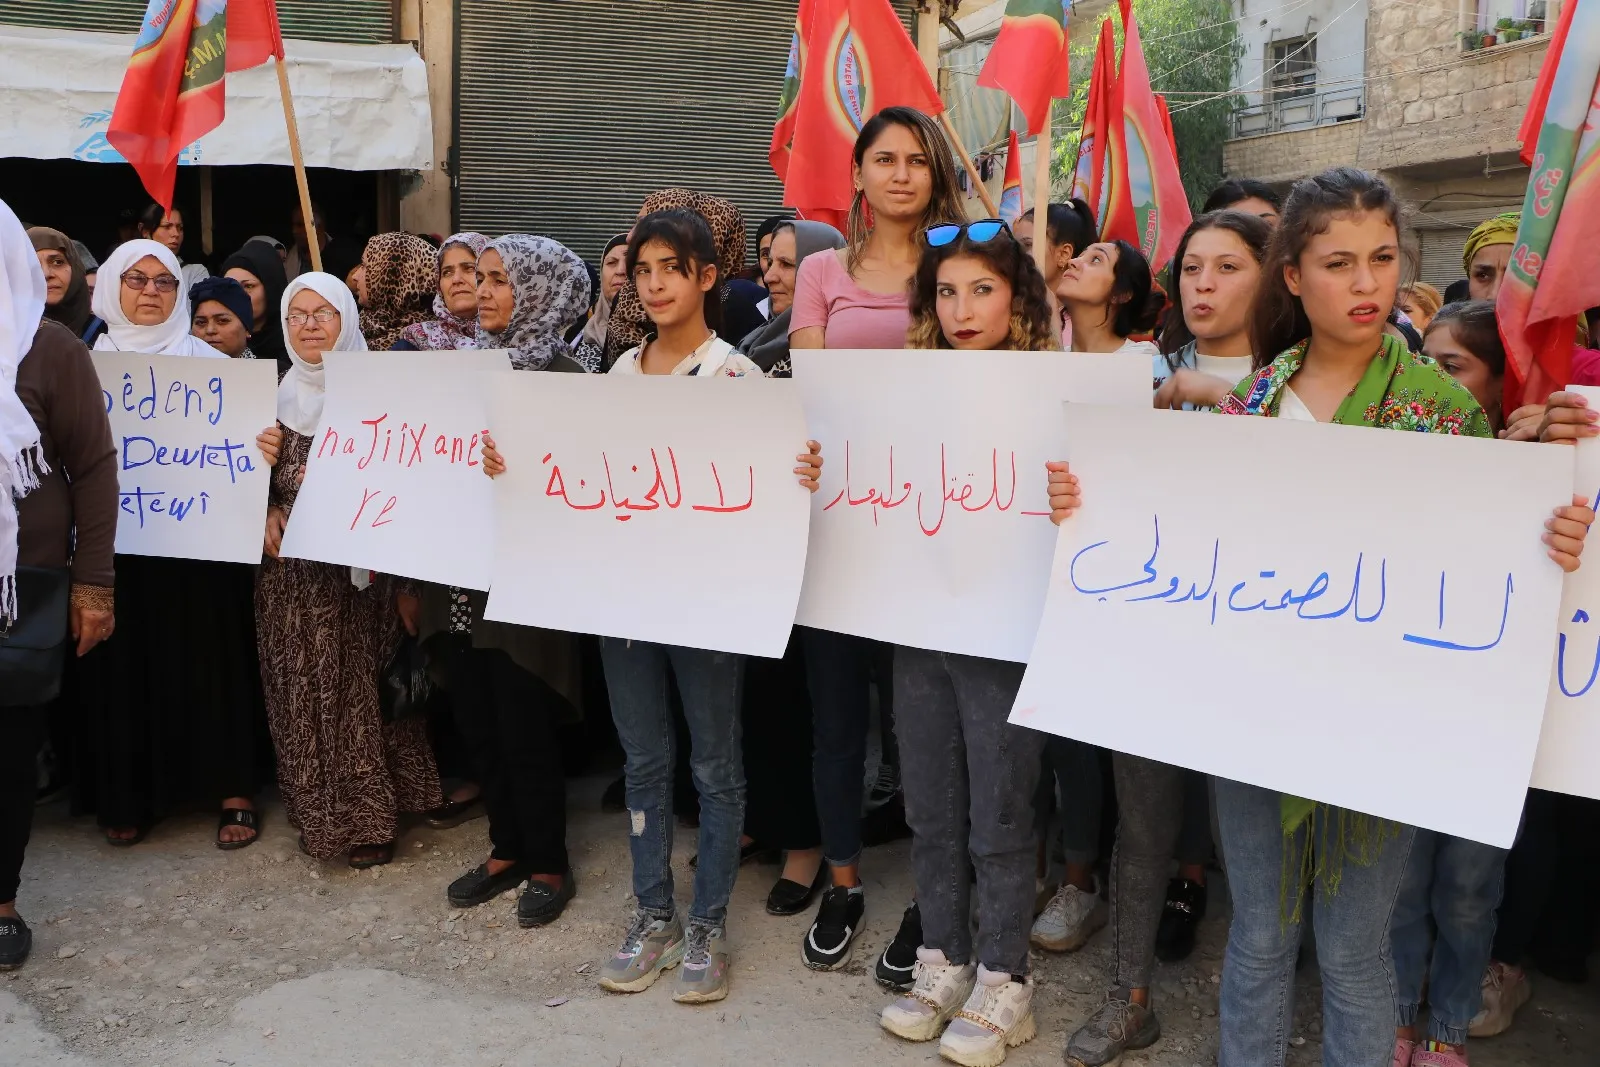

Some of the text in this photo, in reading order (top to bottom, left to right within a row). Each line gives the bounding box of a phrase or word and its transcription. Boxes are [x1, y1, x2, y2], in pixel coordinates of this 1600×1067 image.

[122, 435, 256, 484] Dewleta
[542, 446, 753, 522] لا للخيانة
[118, 486, 211, 530] etewî
[350, 487, 397, 531] re
[1402, 570, 1513, 651] لا
